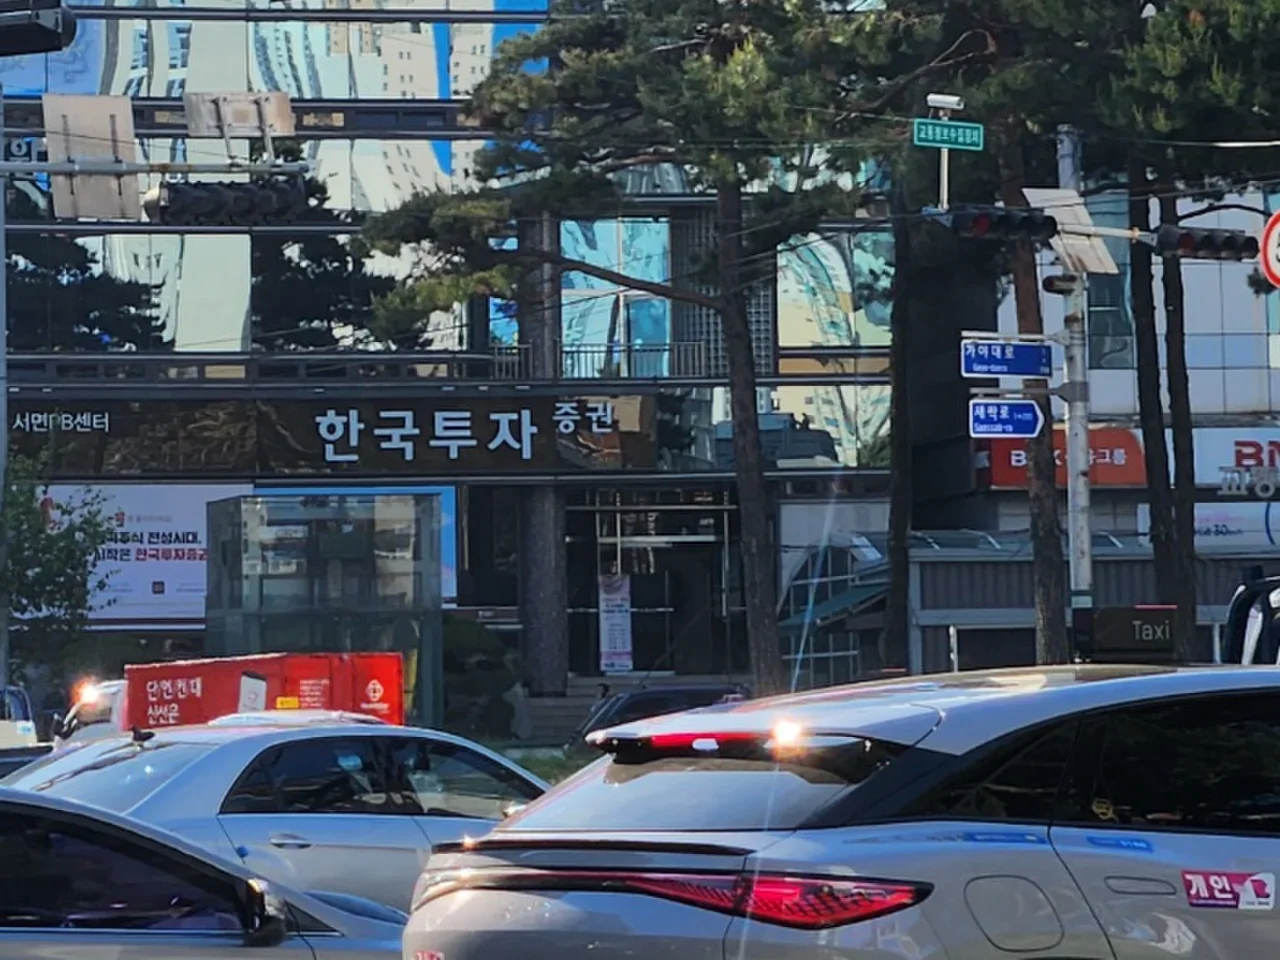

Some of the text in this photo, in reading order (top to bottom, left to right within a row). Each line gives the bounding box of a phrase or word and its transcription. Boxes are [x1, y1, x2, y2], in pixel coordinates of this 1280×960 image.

[965, 344, 1015, 360] 가야대로
[315, 401, 616, 462] 한국투자 증권
[1131, 619, 1170, 640] Taxi
[1184, 873, 1234, 898] 개인
